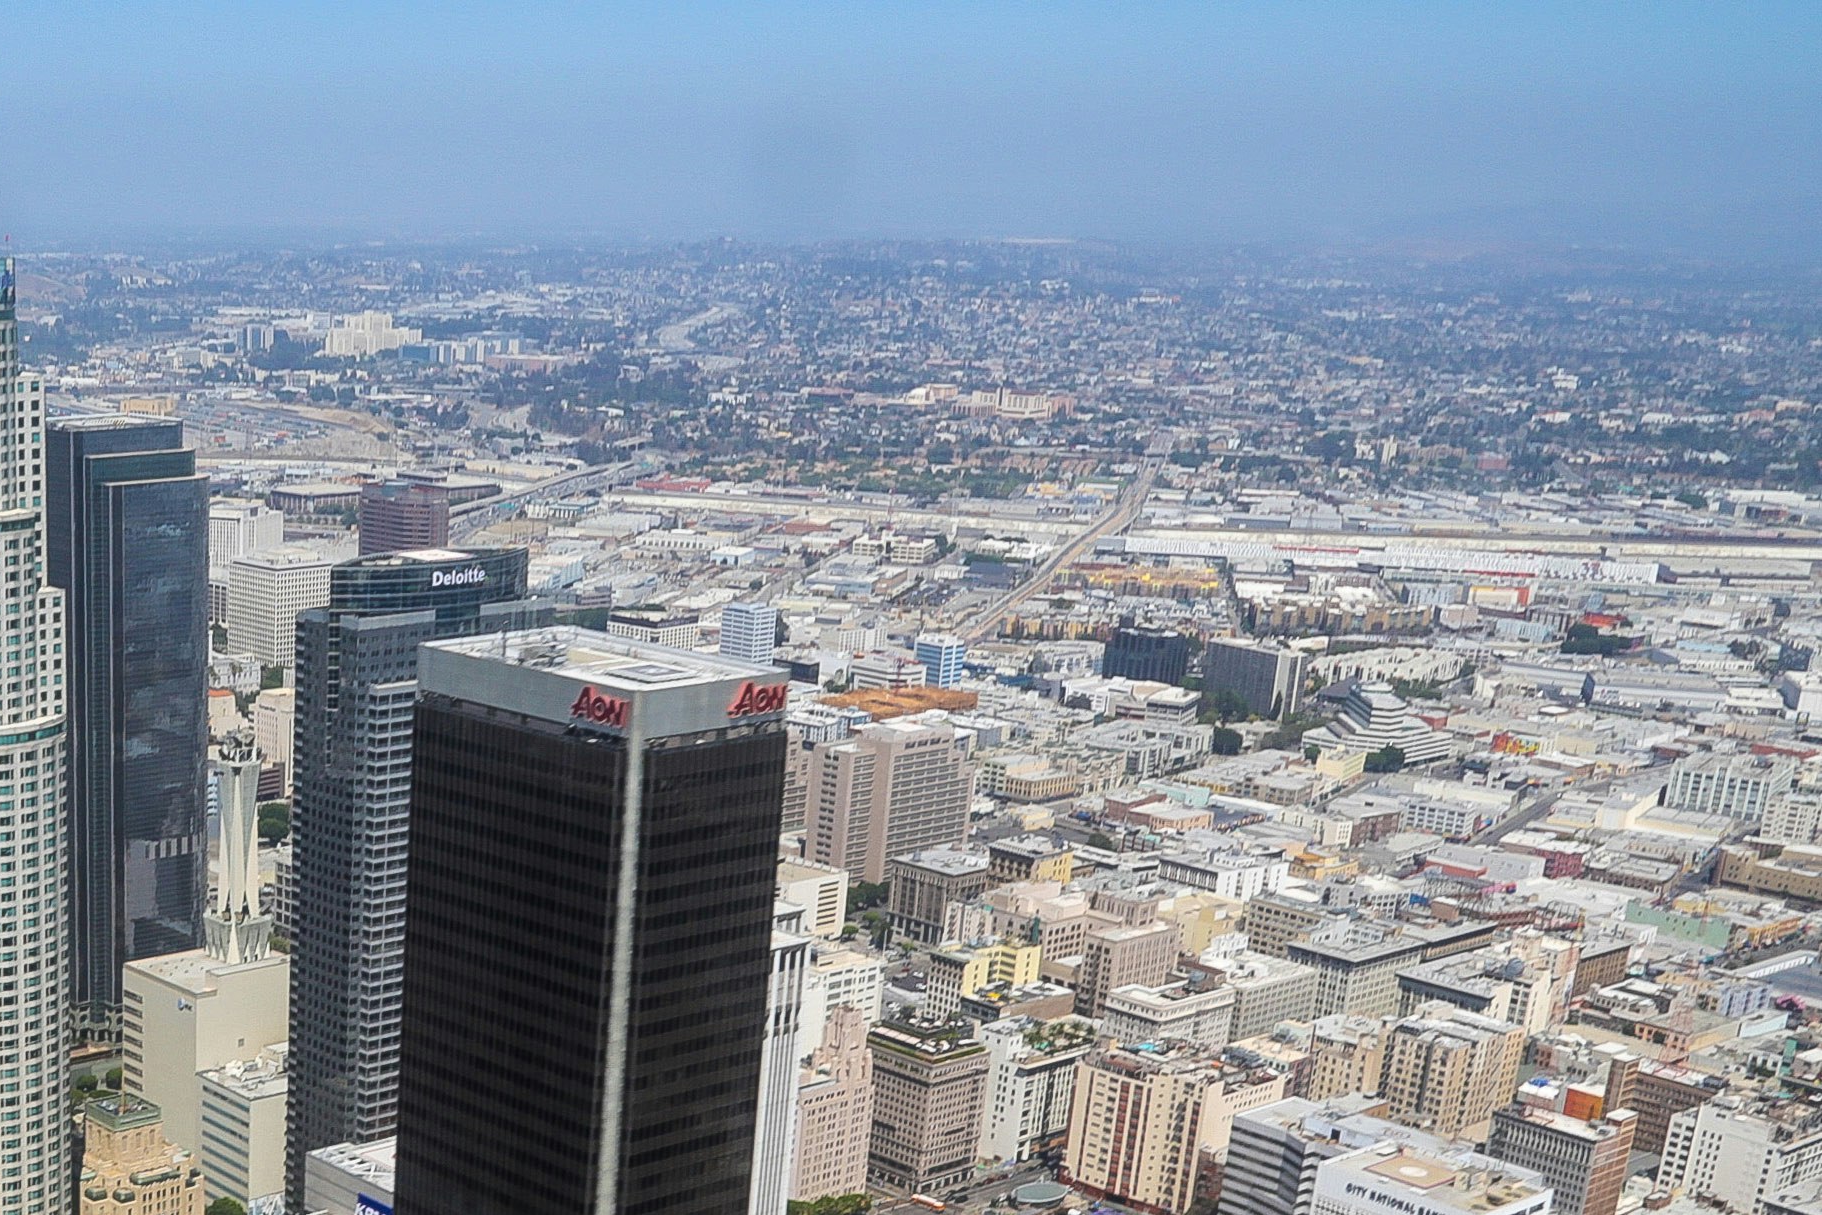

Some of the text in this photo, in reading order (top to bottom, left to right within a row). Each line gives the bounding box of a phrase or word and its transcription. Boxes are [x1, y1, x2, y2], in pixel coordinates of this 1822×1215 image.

[432, 564, 486, 586] Deloitte
[1345, 1182, 1367, 1197] CITY
[1369, 1189, 1415, 1215] NATIONAL
